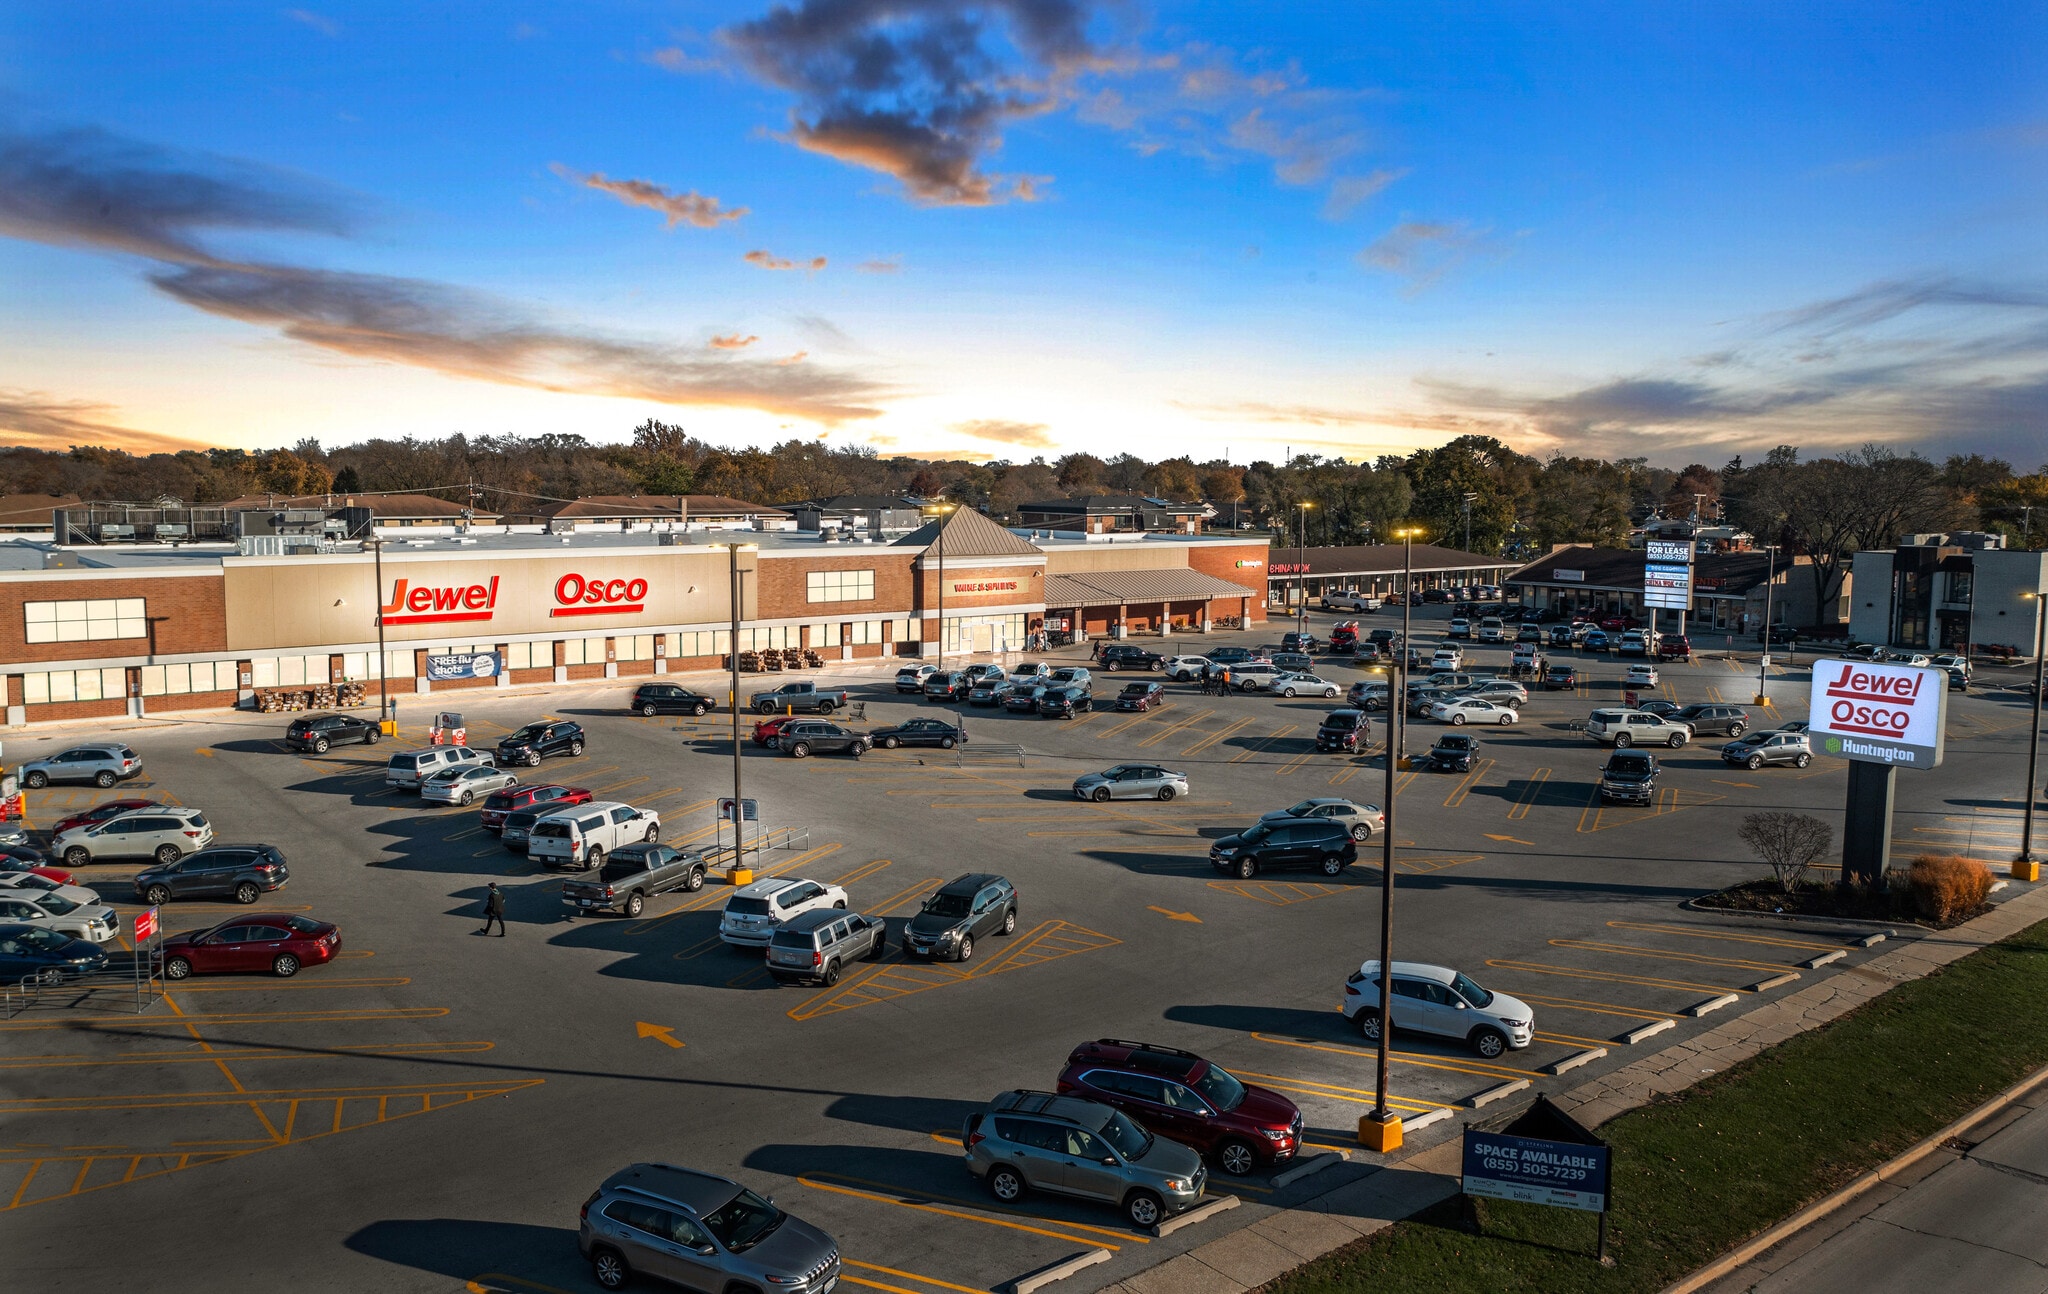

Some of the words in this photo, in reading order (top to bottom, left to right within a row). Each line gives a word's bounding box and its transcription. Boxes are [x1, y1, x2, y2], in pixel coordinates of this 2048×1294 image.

[1647, 546, 1663, 554] FOR
[1664, 547, 1688, 555] LEASE
[1269, 564, 1291, 573] CHINA
[381, 575, 500, 614] Jewel
[554, 573, 648, 605] Osco
[954, 583, 977, 592] WINE
[978, 583, 985, 591] &
[1694, 577, 1724, 587] ENTIST
[434, 656, 457, 666] FREE
[458, 655, 471, 664] flu
[1829, 665, 1924, 697] Jewel
[1831, 700, 1910, 730] Osco
[1843, 739, 1915, 762] Huntington
[1474, 1143, 1518, 1159] SPACE
[1521, 1150, 1596, 1169] AVAILABLE
[1483, 1157, 1519, 1172] (855)
[1522, 1163, 1586, 1180] 505-7239
